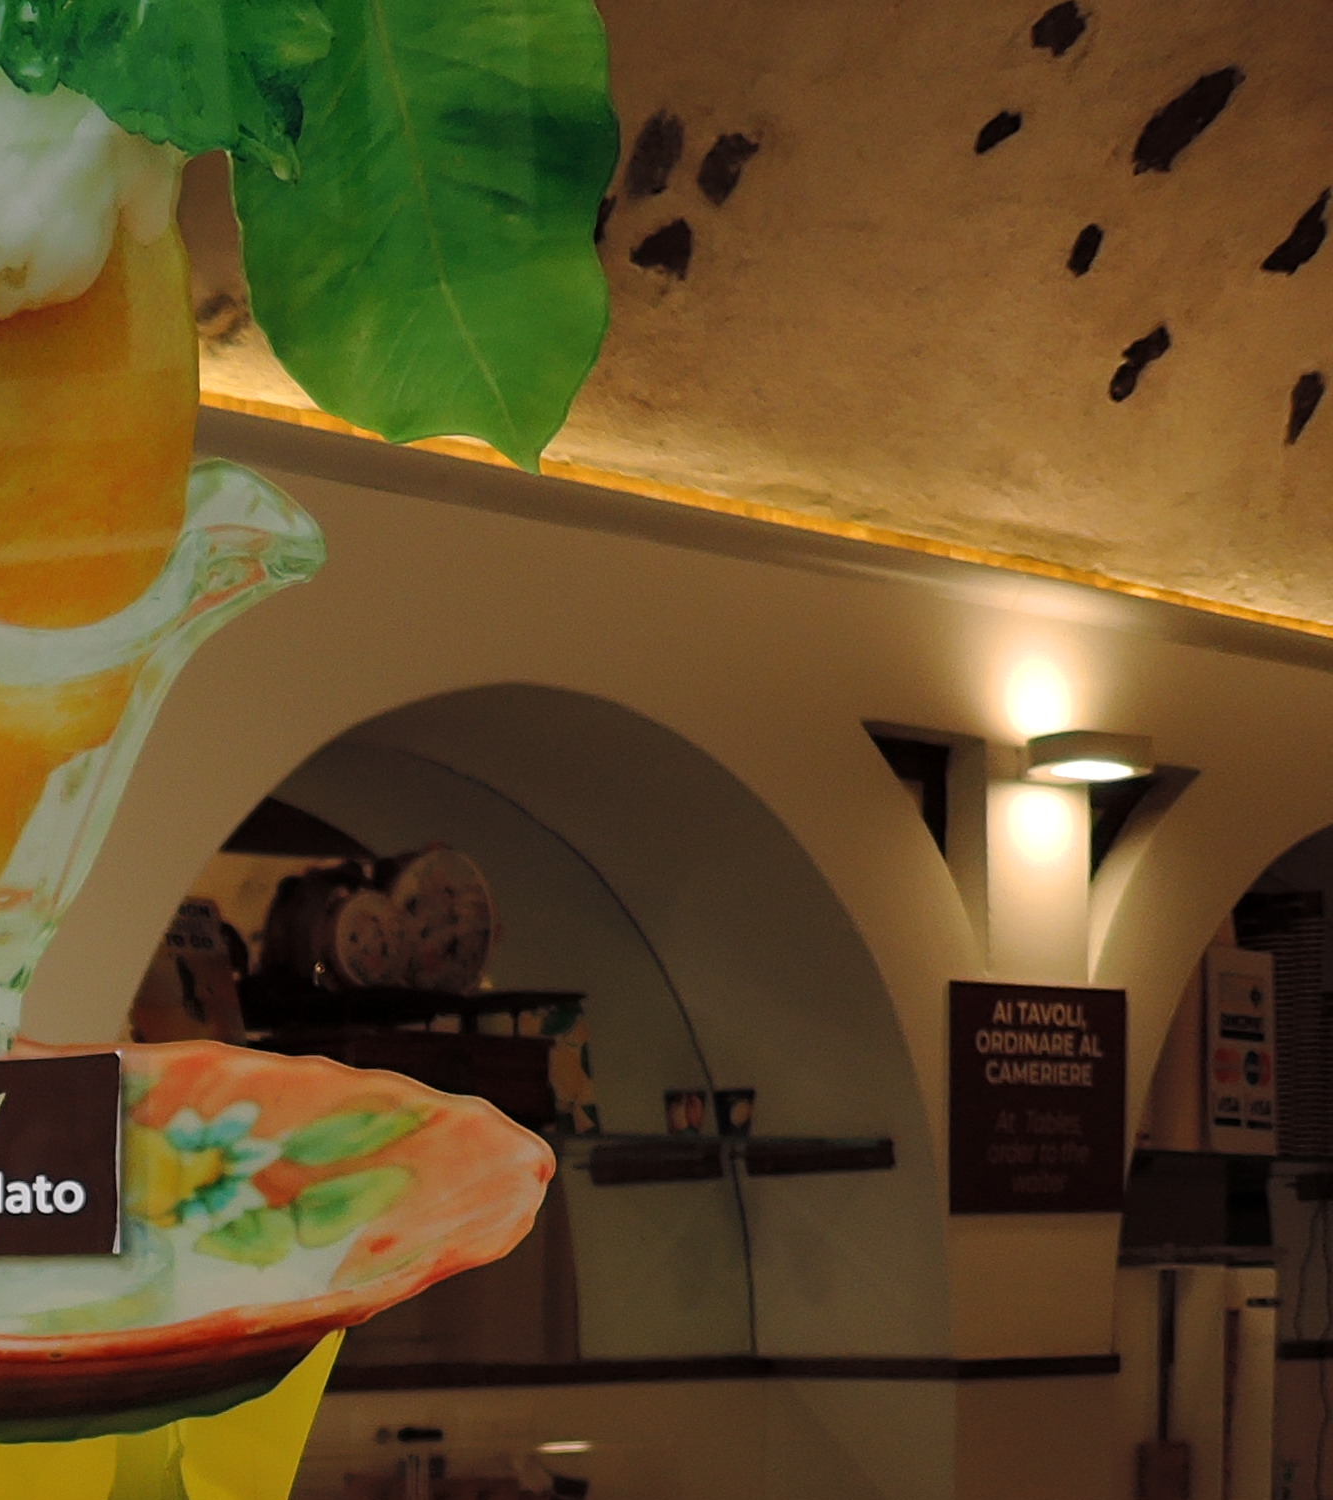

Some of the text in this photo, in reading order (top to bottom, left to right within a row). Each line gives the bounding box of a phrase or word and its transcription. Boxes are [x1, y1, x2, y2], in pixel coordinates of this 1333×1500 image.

[993, 1001, 1013, 1025] AI
[975, 1029, 1103, 1058] ORDINARE AL
[985, 1059, 1093, 1087] CAMERIERE
